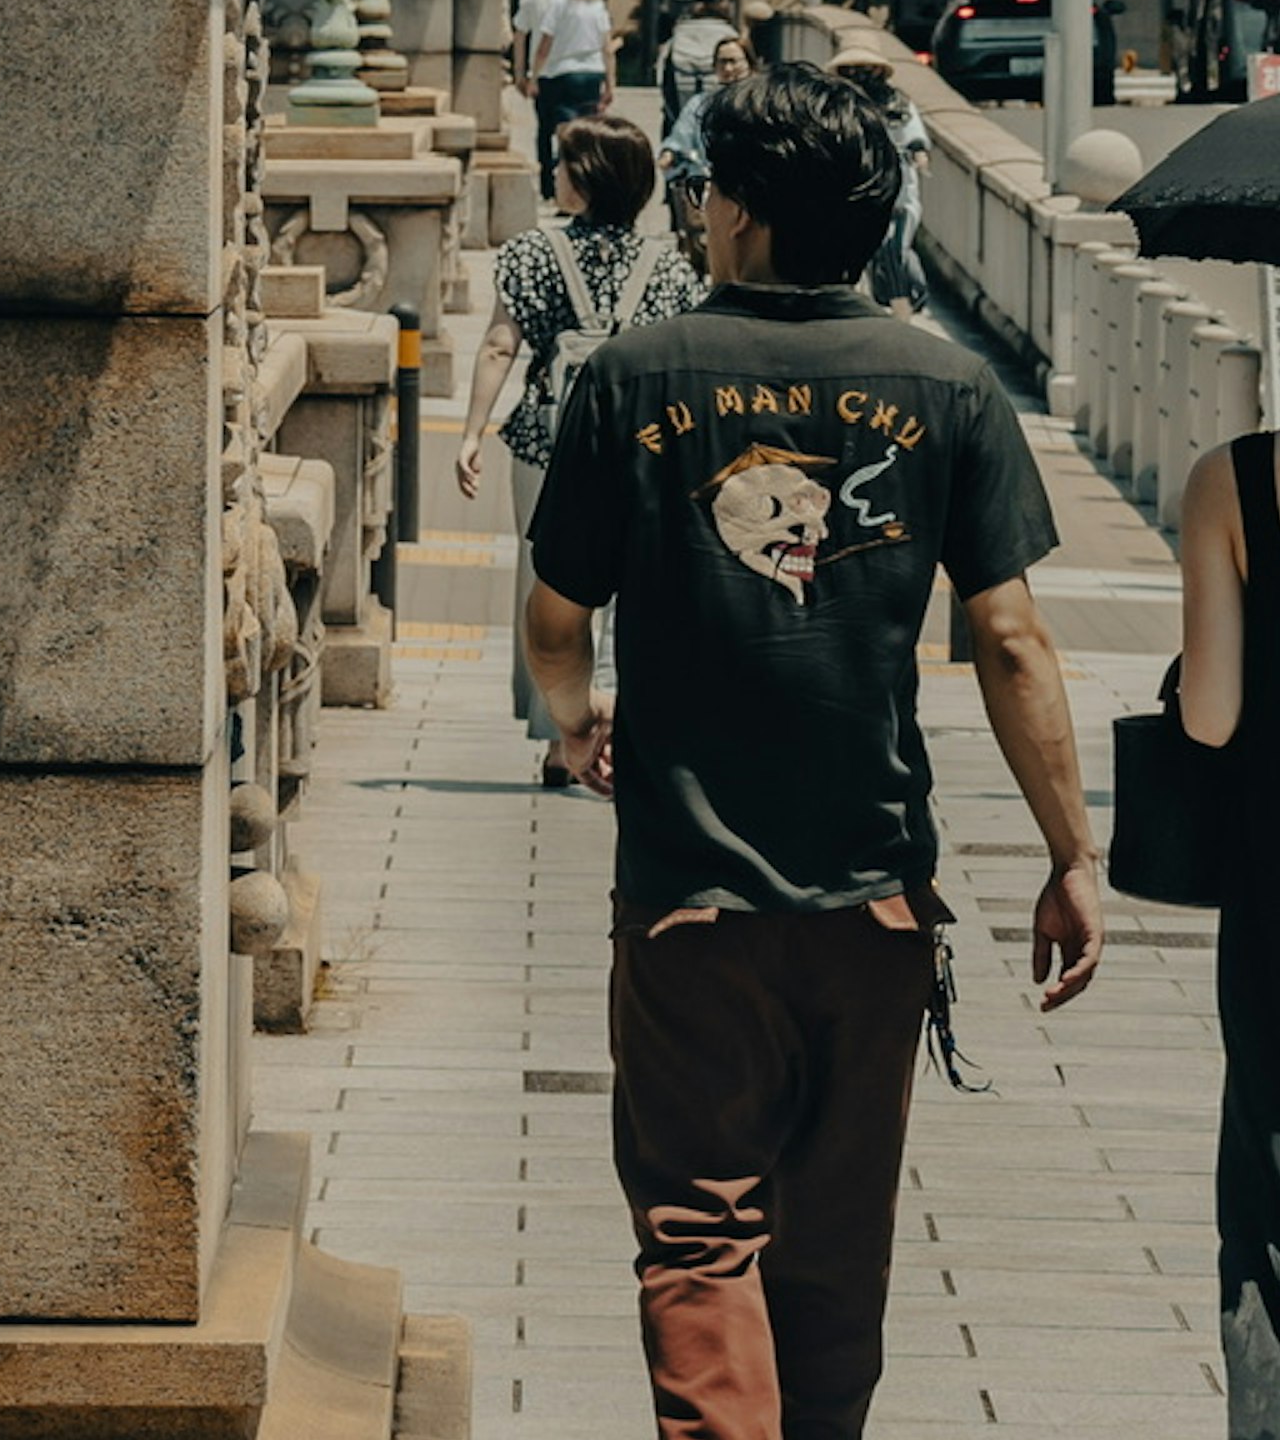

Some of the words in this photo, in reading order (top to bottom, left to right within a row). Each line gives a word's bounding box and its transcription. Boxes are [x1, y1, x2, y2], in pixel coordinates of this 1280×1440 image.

[635, 400, 696, 454] FU
[714, 383, 814, 417] MAN
[836, 390, 927, 451] CHU
